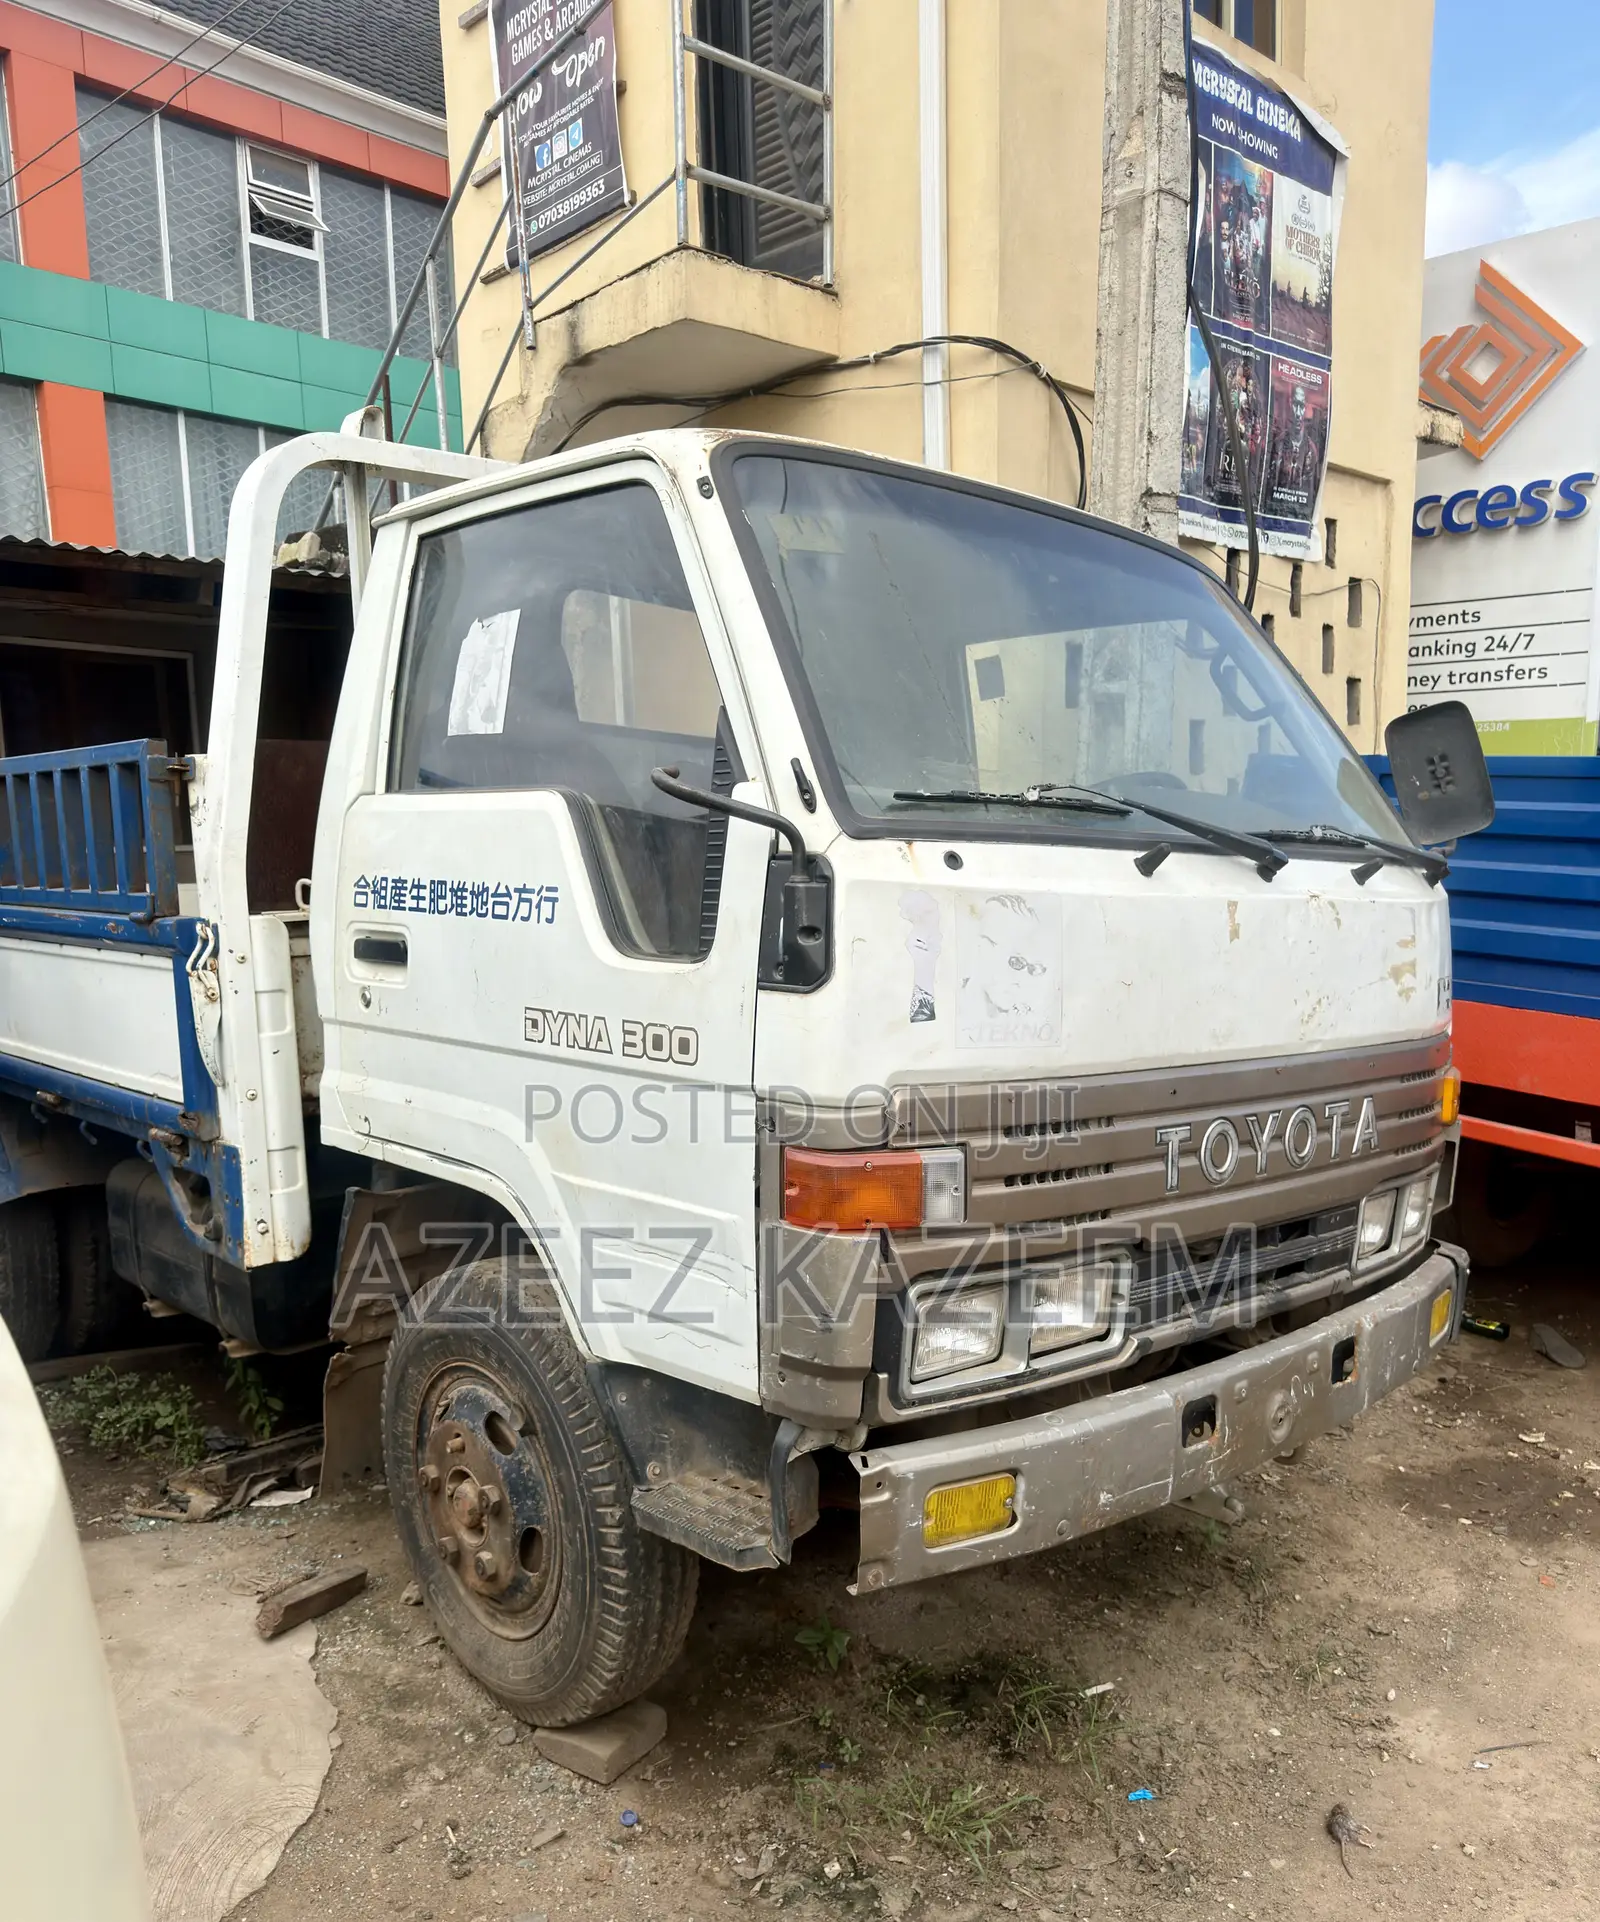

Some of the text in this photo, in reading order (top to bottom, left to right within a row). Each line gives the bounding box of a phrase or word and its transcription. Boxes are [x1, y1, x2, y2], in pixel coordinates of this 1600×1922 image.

[506, 0, 553, 42] MCRYSTAL
[511, 25, 542, 66] GAMES
[544, 18, 553, 41] &
[1211, 113, 1278, 159] NOW SHOWING
[1256, 96, 1301, 142] CINEMA
[527, 162, 562, 189] MCRYSTAL
[563, 142, 592, 169] CINEMAS
[538, 178, 605, 229] 07038199363
[1285, 224, 1320, 249] MOTHERS
[1278, 362, 1322, 384] HEADLESS
[1412, 472, 1598, 538] ccess
[1408, 632, 1535, 658] anking 24/7
[1407, 664, 1548, 690] ney transfers
[524, 1006, 698, 1066] DYNA 300
[1155, 1095, 1380, 1195] TOYOTA
